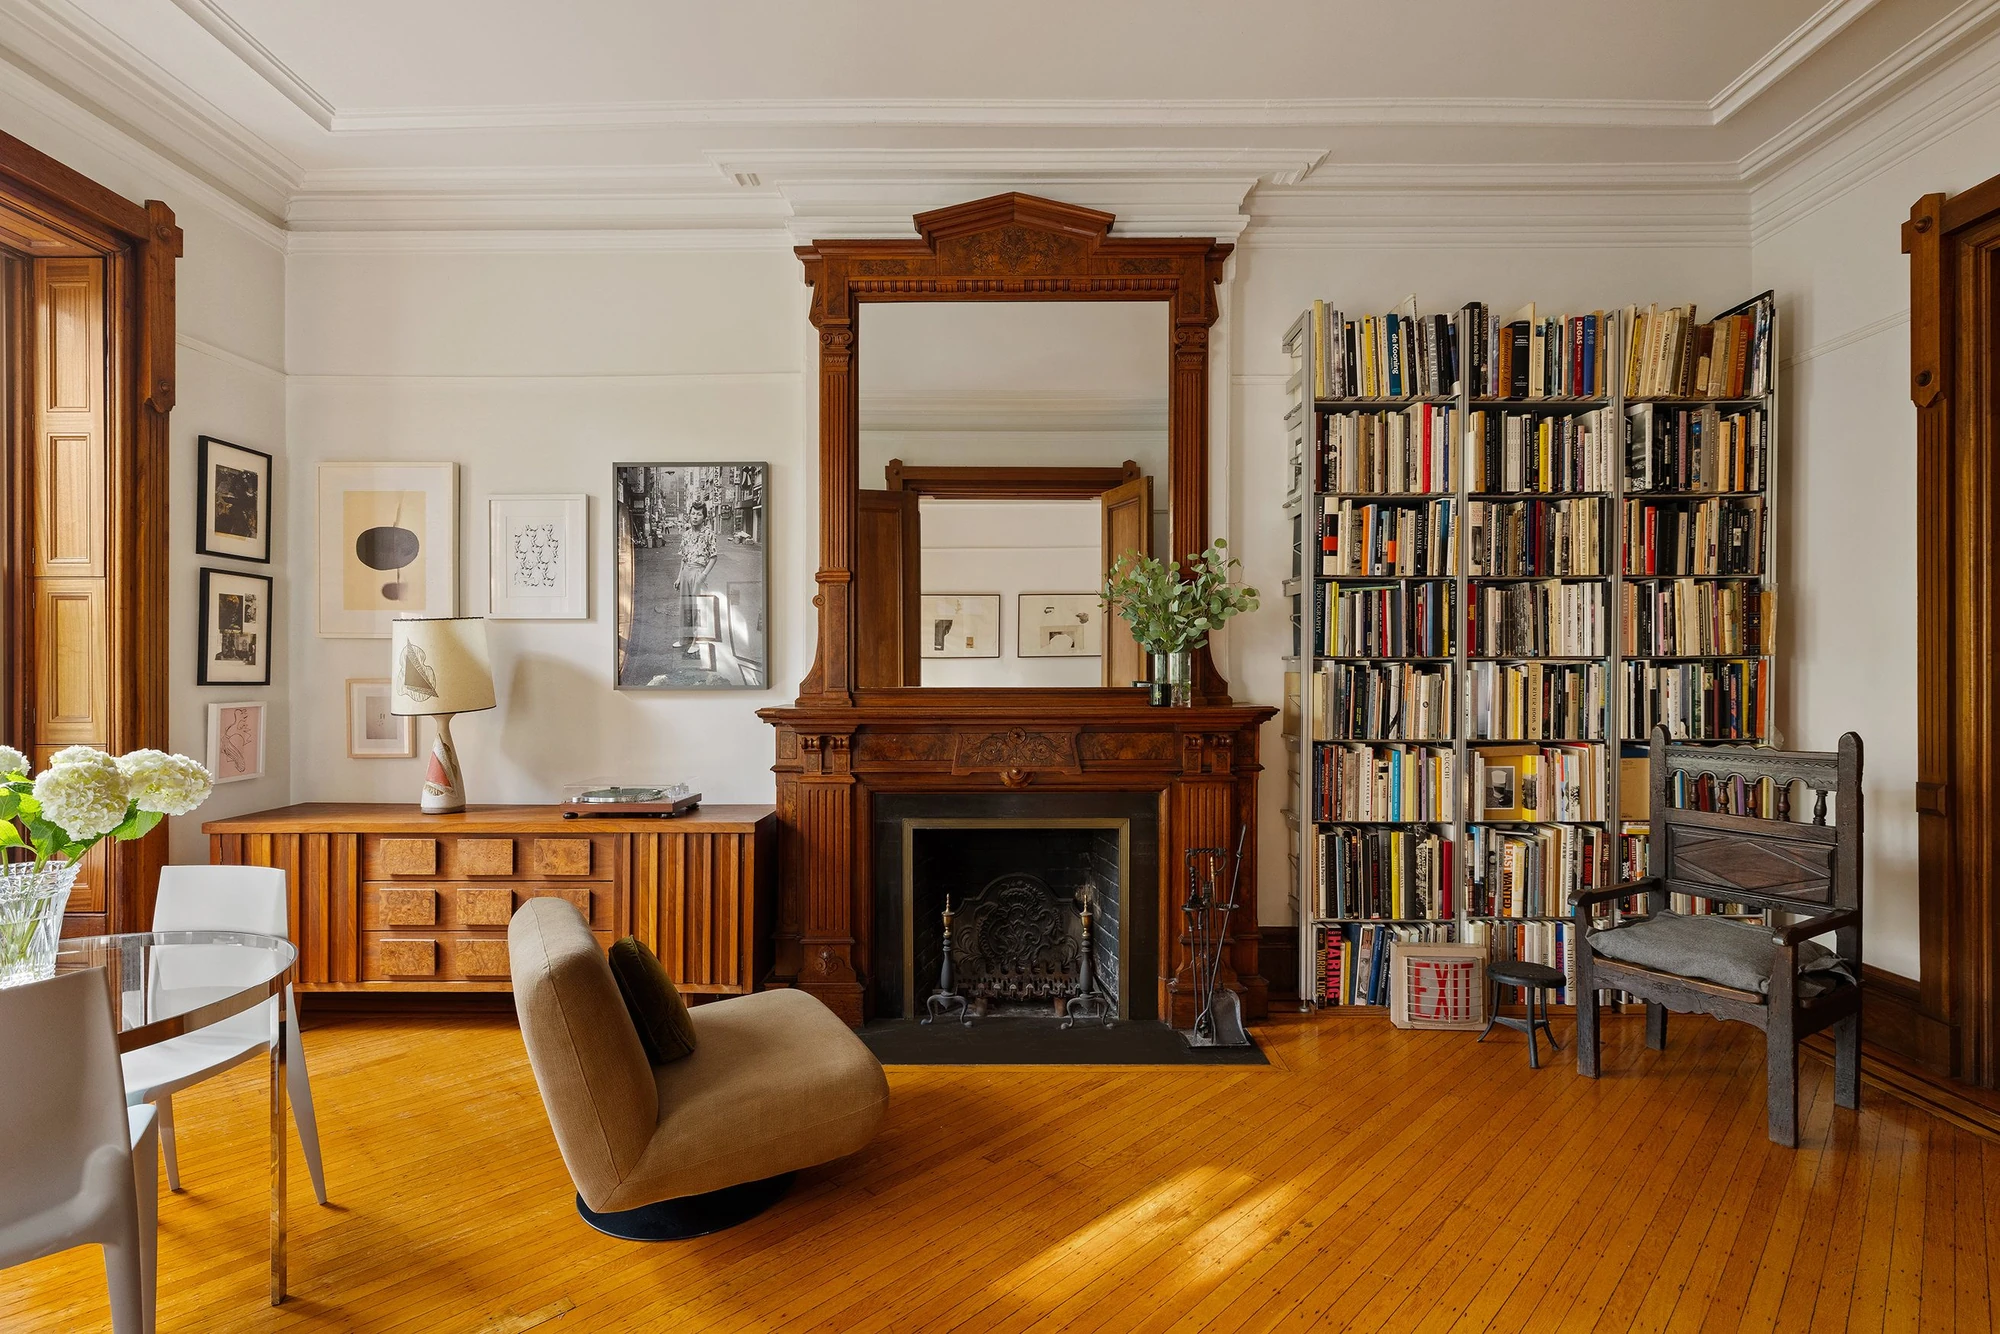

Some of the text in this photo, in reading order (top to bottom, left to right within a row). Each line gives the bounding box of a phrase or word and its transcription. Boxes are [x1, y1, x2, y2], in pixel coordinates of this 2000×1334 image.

[1391, 333, 1400, 375] de Kooning
[1428, 323, 1439, 383] IT'S ALL TRUE
[1661, 333, 1670, 361] Mondrian
[1502, 843, 1514, 909] LEAST WANTED
[1316, 948, 1326, 998] WARHOL LIVE
[1327, 936, 1342, 999] HARING
[1414, 962, 1474, 1020] EXIT
